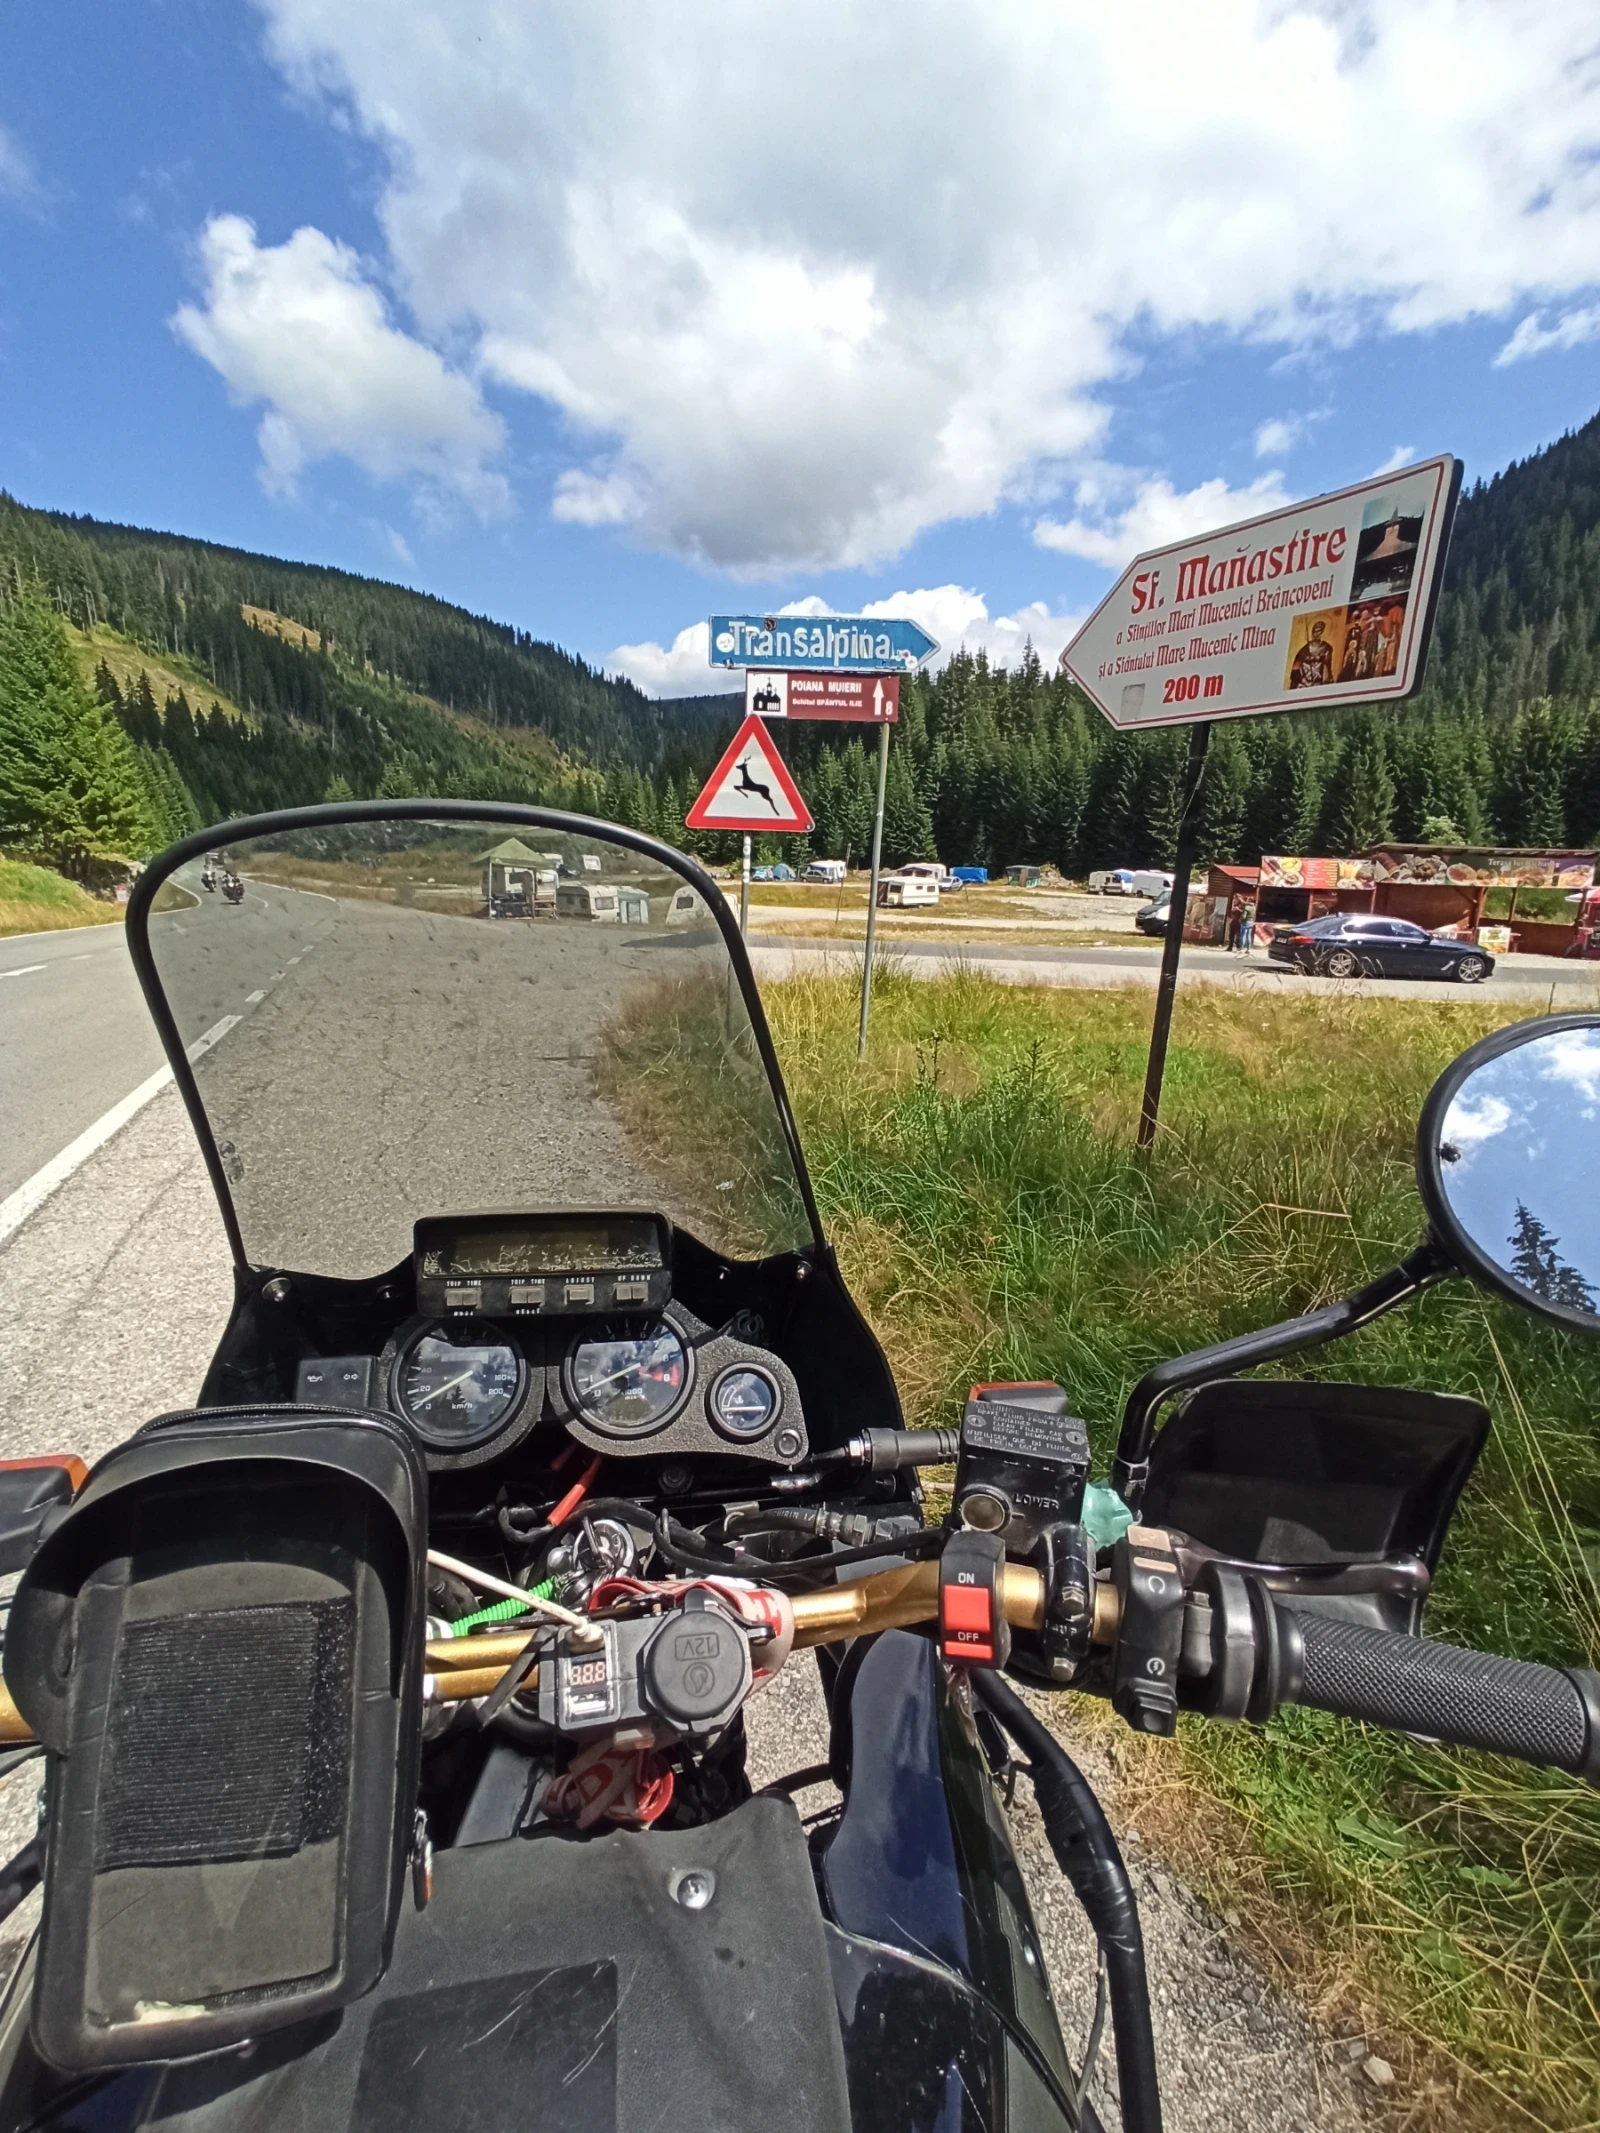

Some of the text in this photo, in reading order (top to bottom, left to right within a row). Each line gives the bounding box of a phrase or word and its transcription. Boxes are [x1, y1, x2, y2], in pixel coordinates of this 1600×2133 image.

[1131, 570, 1165, 614] Sf.
[1116, 631, 1123, 646] a
[1168, 608, 1196, 634] Mari
[1198, 595, 1253, 627] Mucenici
[1256, 574, 1335, 614] Brâncoveni
[728, 620, 891, 667] Transalpina
[1107, 662, 1113, 676] a
[1156, 644, 1186, 667] Mare
[1188, 632, 1238, 661] Mucenic
[1240, 625, 1277, 651] Mina
[791, 679, 862, 693] POIANA MUIERII
[1162, 674, 1224, 704] 200 m
[885, 701, 893, 715] 8
[1015, 1493, 1060, 1510] LOWER
[957, 1572, 975, 1584] ON
[682, 1636, 712, 1656] 12V
[957, 1631, 979, 1642] OFF
